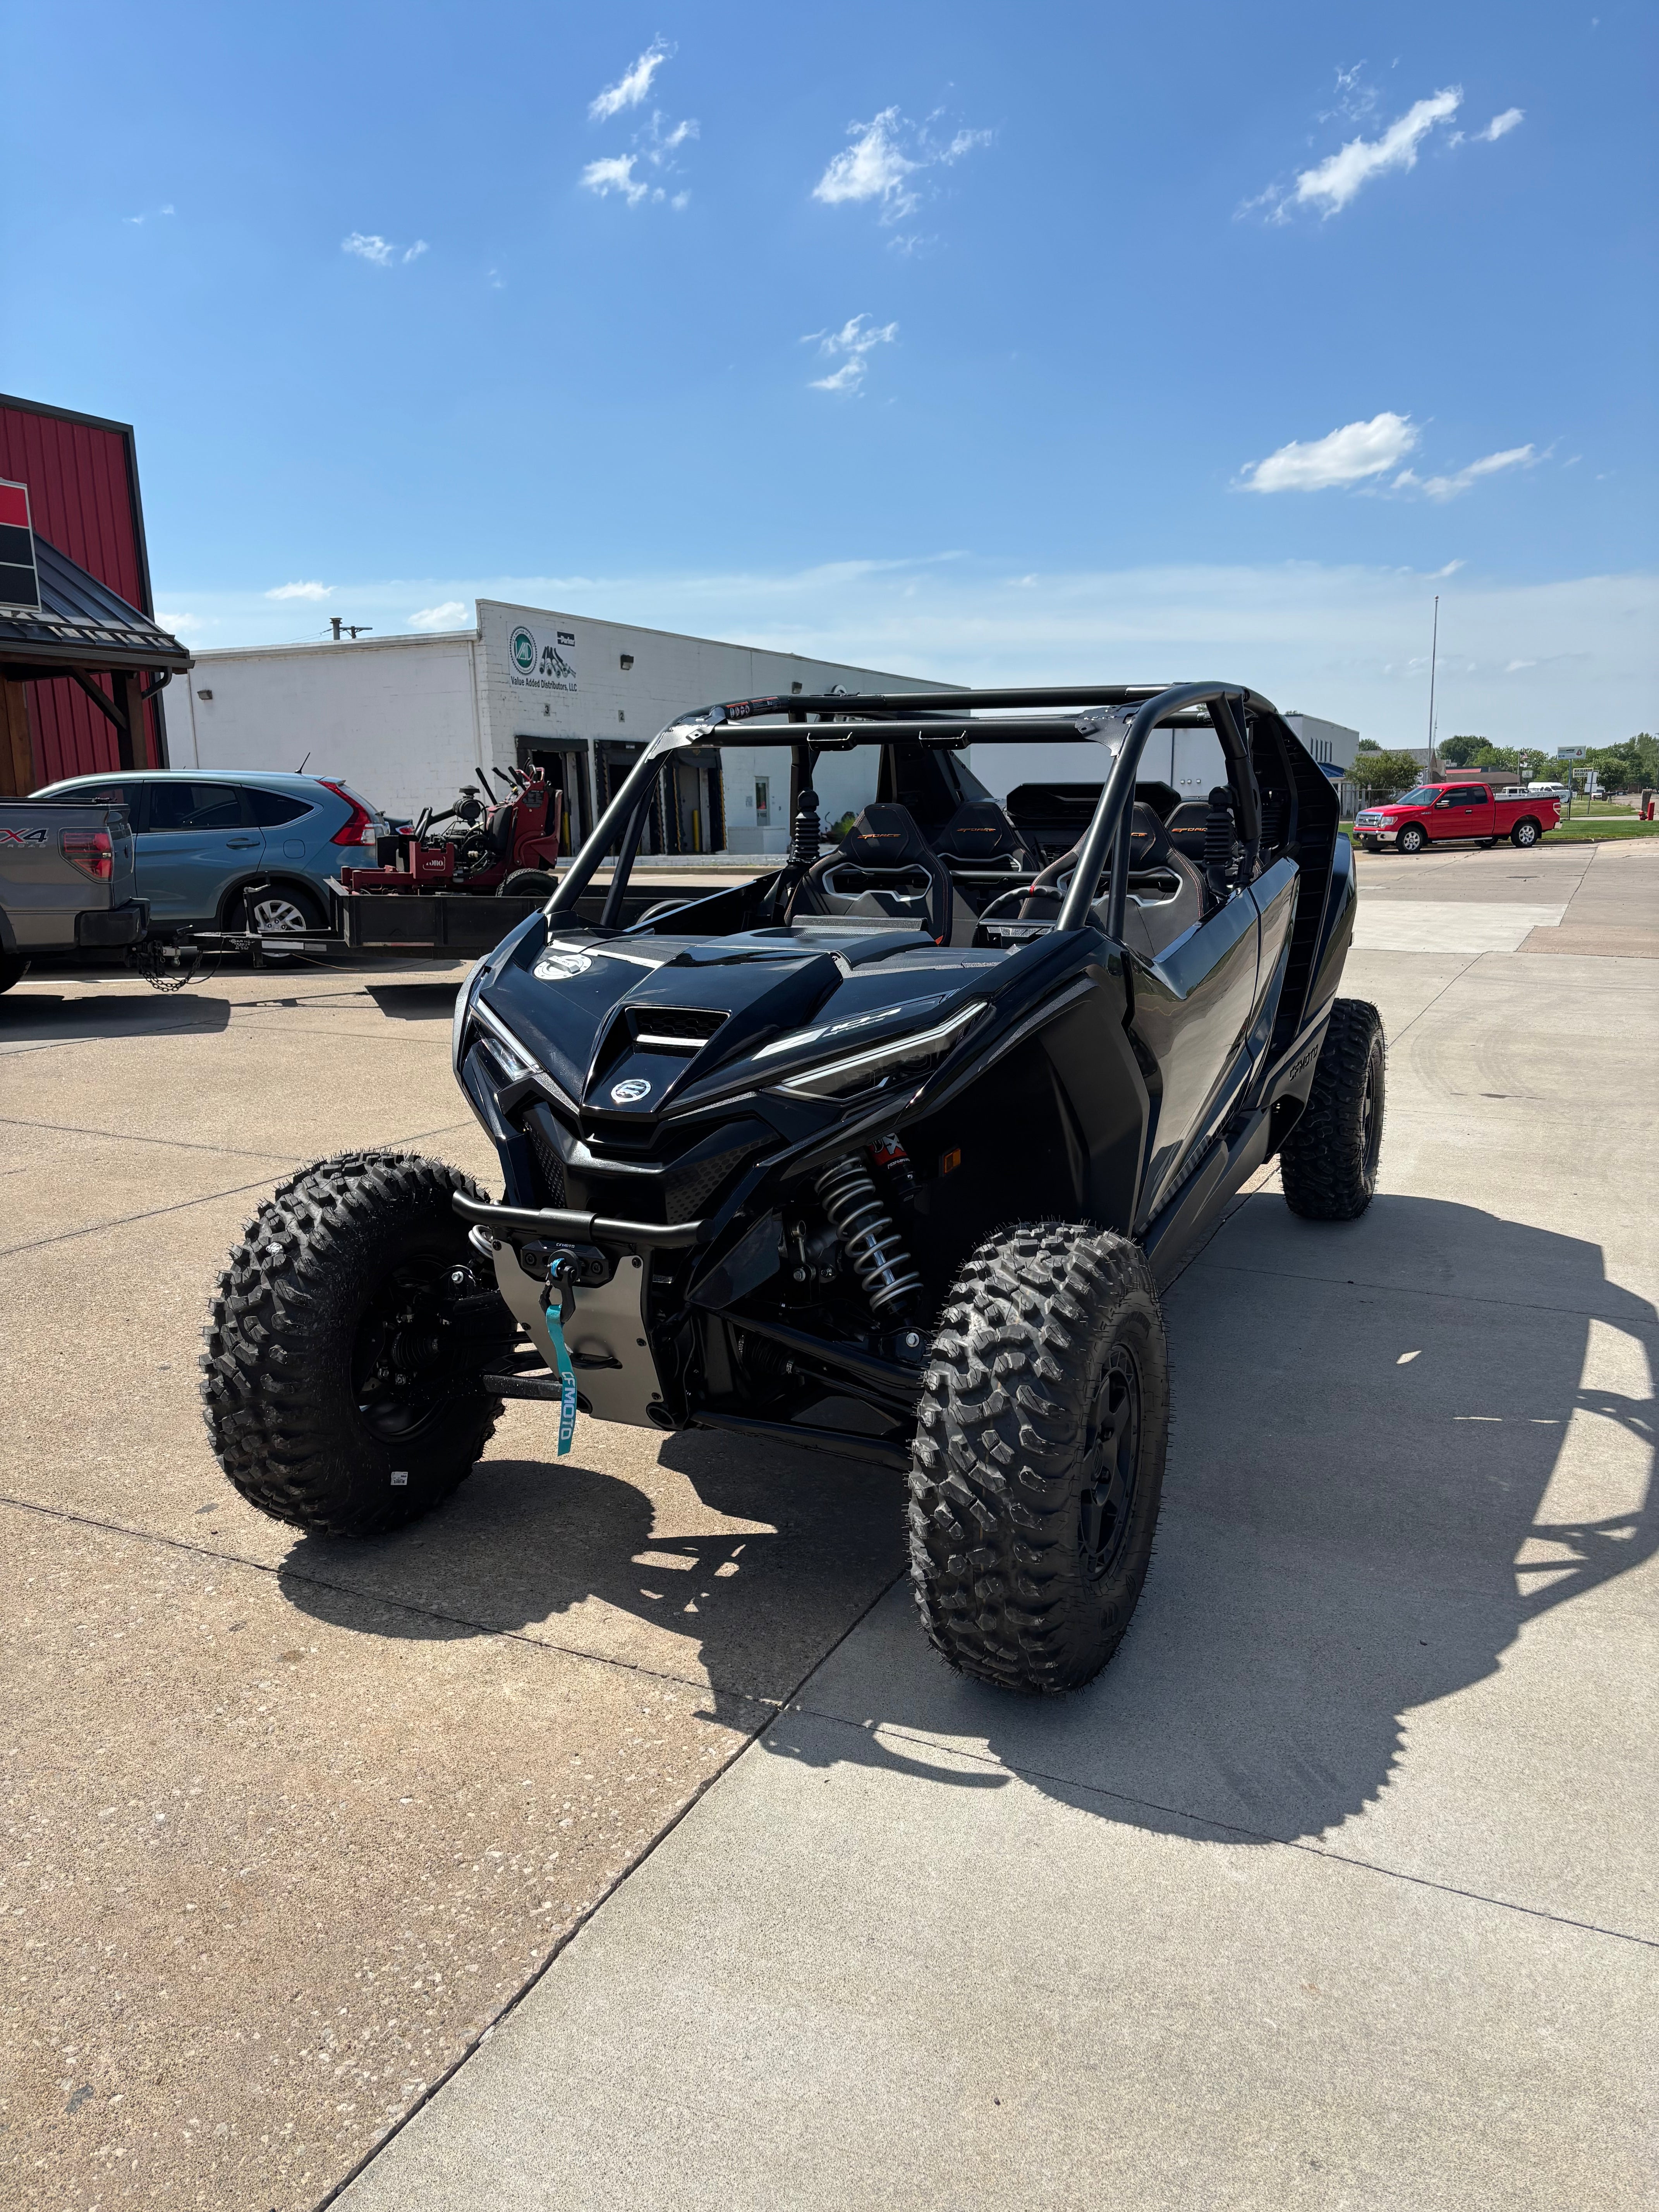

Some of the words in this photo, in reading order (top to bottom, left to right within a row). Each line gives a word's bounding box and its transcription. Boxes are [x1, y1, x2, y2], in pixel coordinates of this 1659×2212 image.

[511, 676, 525, 686] Value
[526, 678, 540, 688] Added
[541, 680, 568, 692] Distributors,
[544, 705, 550, 714] 3
[620, 712, 624, 720] 2
[1290, 1044, 1318, 1082] CFMOTO
[561, 1372, 575, 1440] CFMOTO
